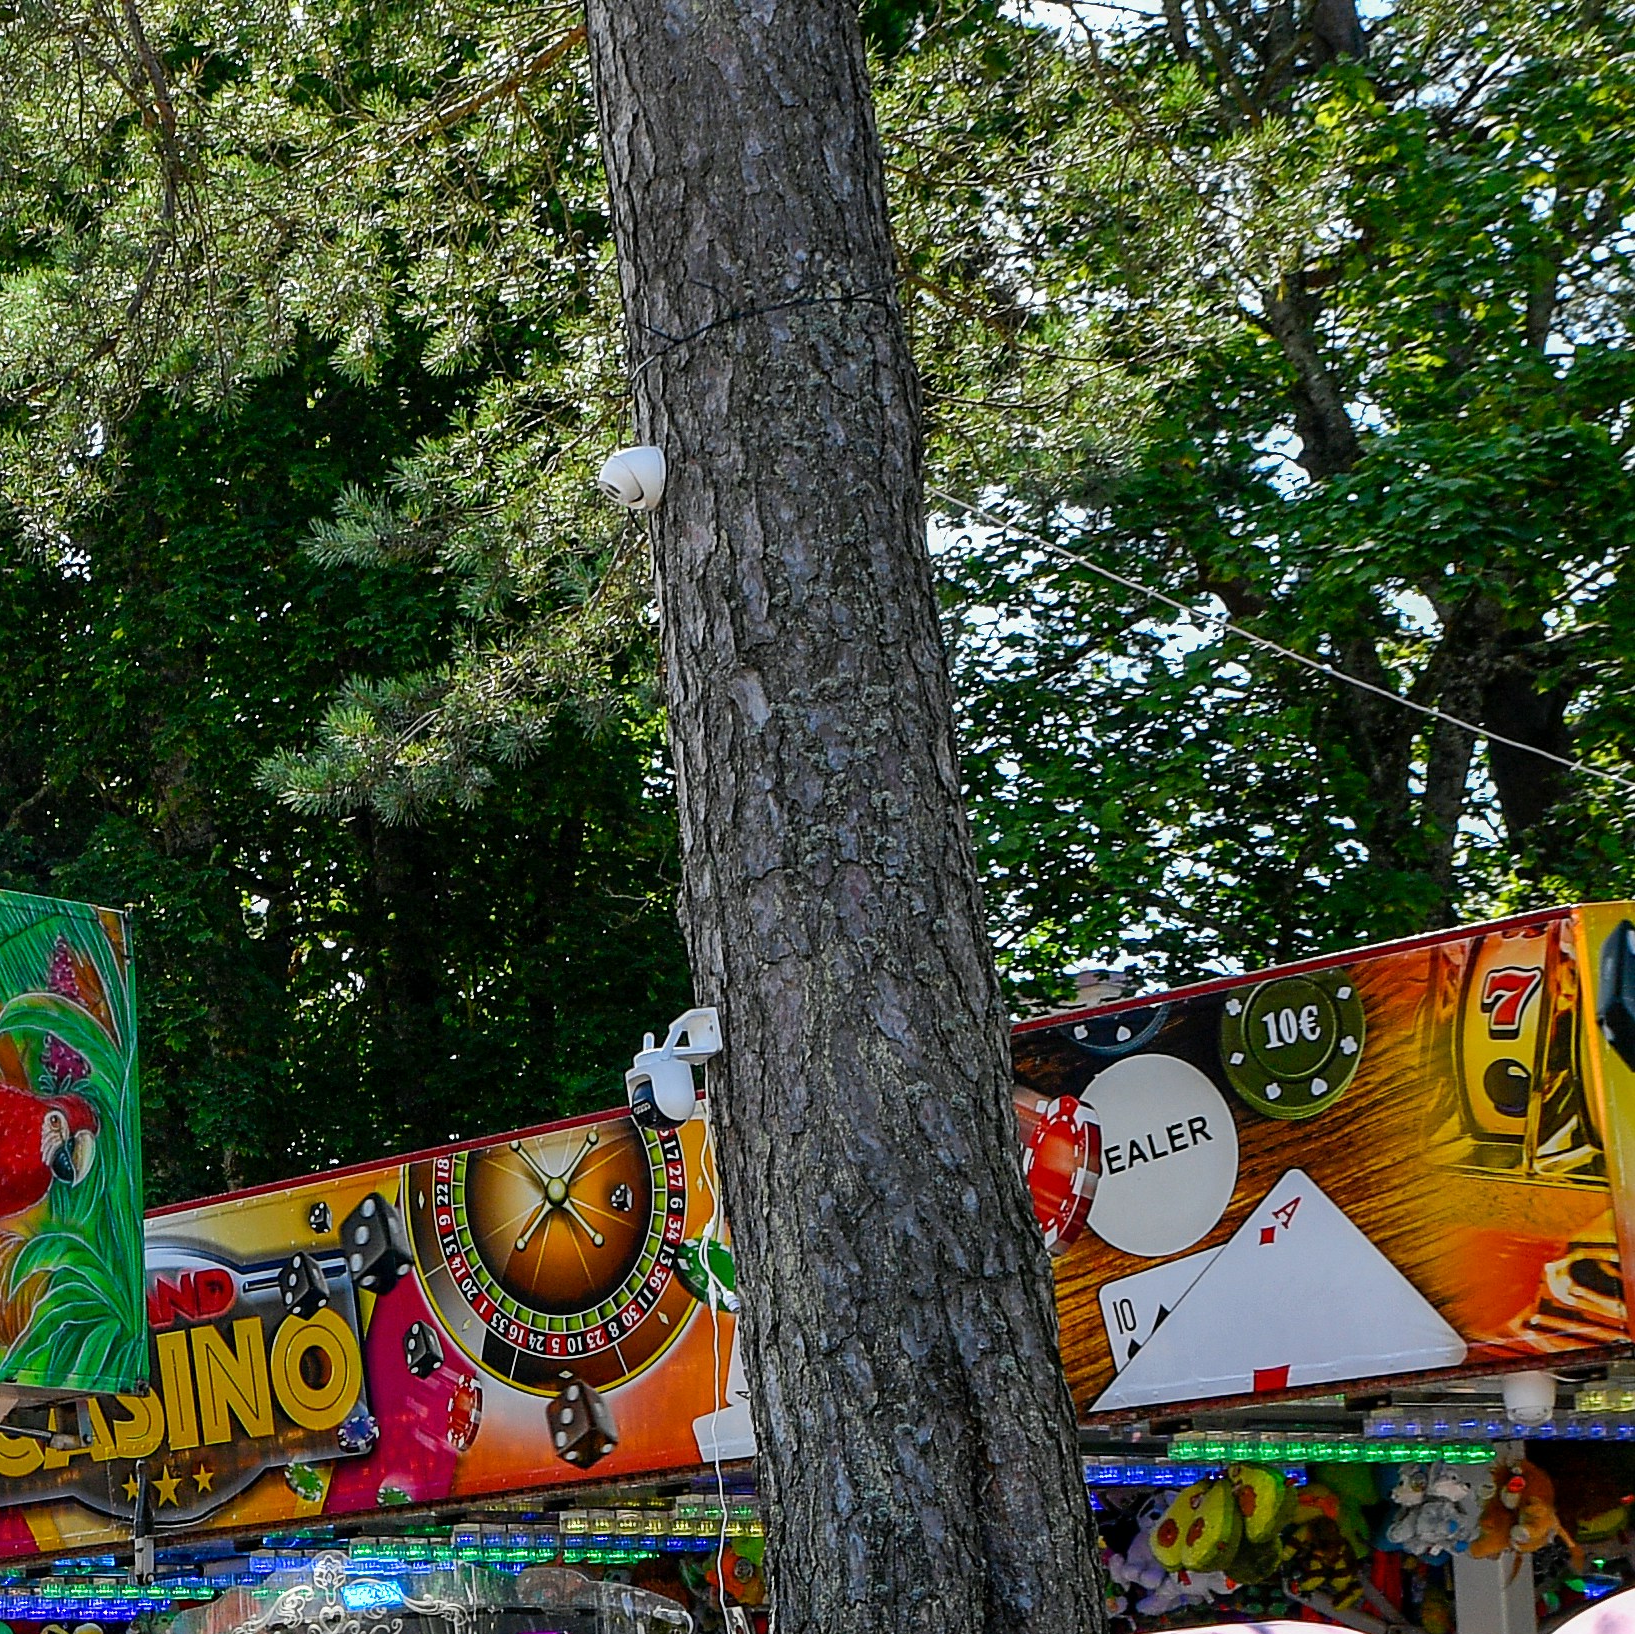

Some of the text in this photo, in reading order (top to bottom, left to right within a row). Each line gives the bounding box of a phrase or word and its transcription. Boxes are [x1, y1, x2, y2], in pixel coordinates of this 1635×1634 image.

[1483, 966, 1543, 1038] 7
[1260, 1004, 1322, 1050] 10€
[1099, 1115, 1213, 1179] EALER
[1272, 1195, 1302, 1230] A
[1111, 1298, 1138, 1335] 10
